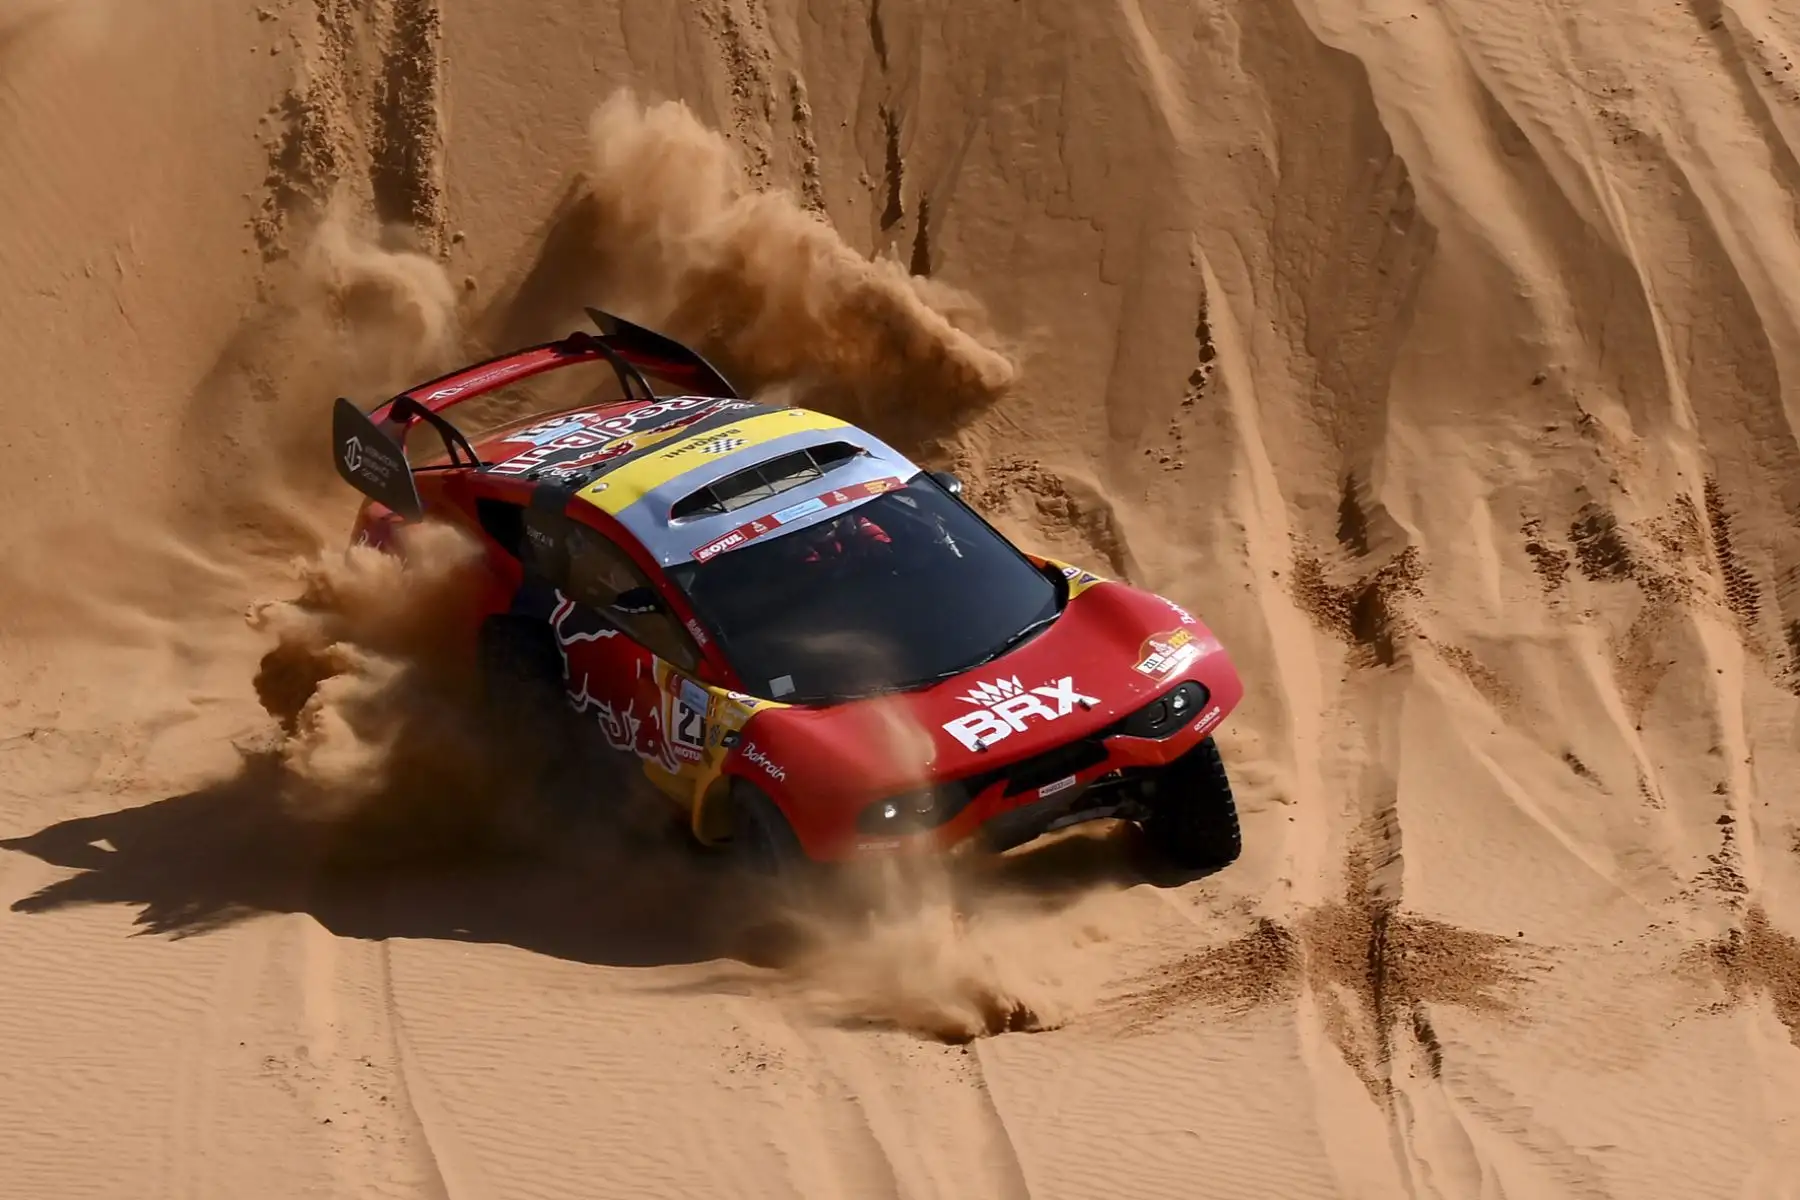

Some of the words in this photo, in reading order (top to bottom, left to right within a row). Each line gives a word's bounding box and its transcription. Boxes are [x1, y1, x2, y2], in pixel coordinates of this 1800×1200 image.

[598, 395, 714, 437] Red
[487, 428, 611, 475] Bull
[660, 428, 741, 460] BARDAHL
[699, 533, 742, 559] MOTUL
[941, 675, 1102, 753] BRX
[741, 742, 786, 783] Bahrain
